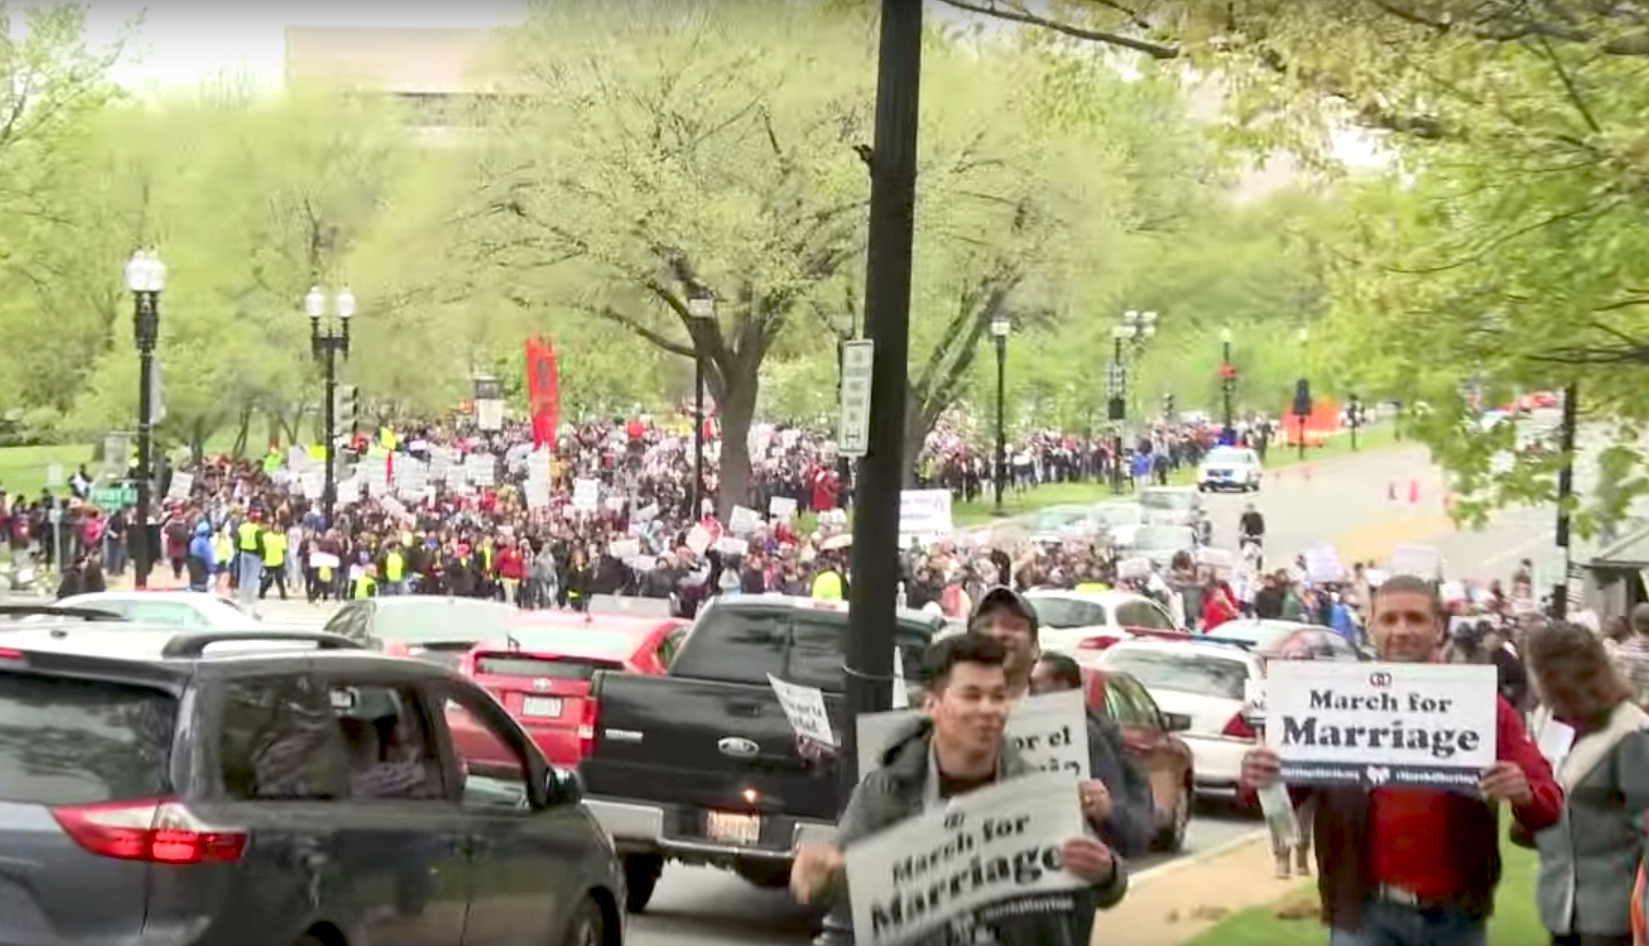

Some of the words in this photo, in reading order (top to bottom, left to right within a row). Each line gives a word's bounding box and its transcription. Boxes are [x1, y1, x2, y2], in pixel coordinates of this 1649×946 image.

[1309, 690, 1398, 713] March
[1408, 693, 1453, 713] for
[1049, 725, 1072, 748] el
[1282, 716, 1480, 758] Marriage
[892, 833, 975, 885] March
[983, 813, 1031, 843] for
[870, 844, 1062, 939] Marriage
